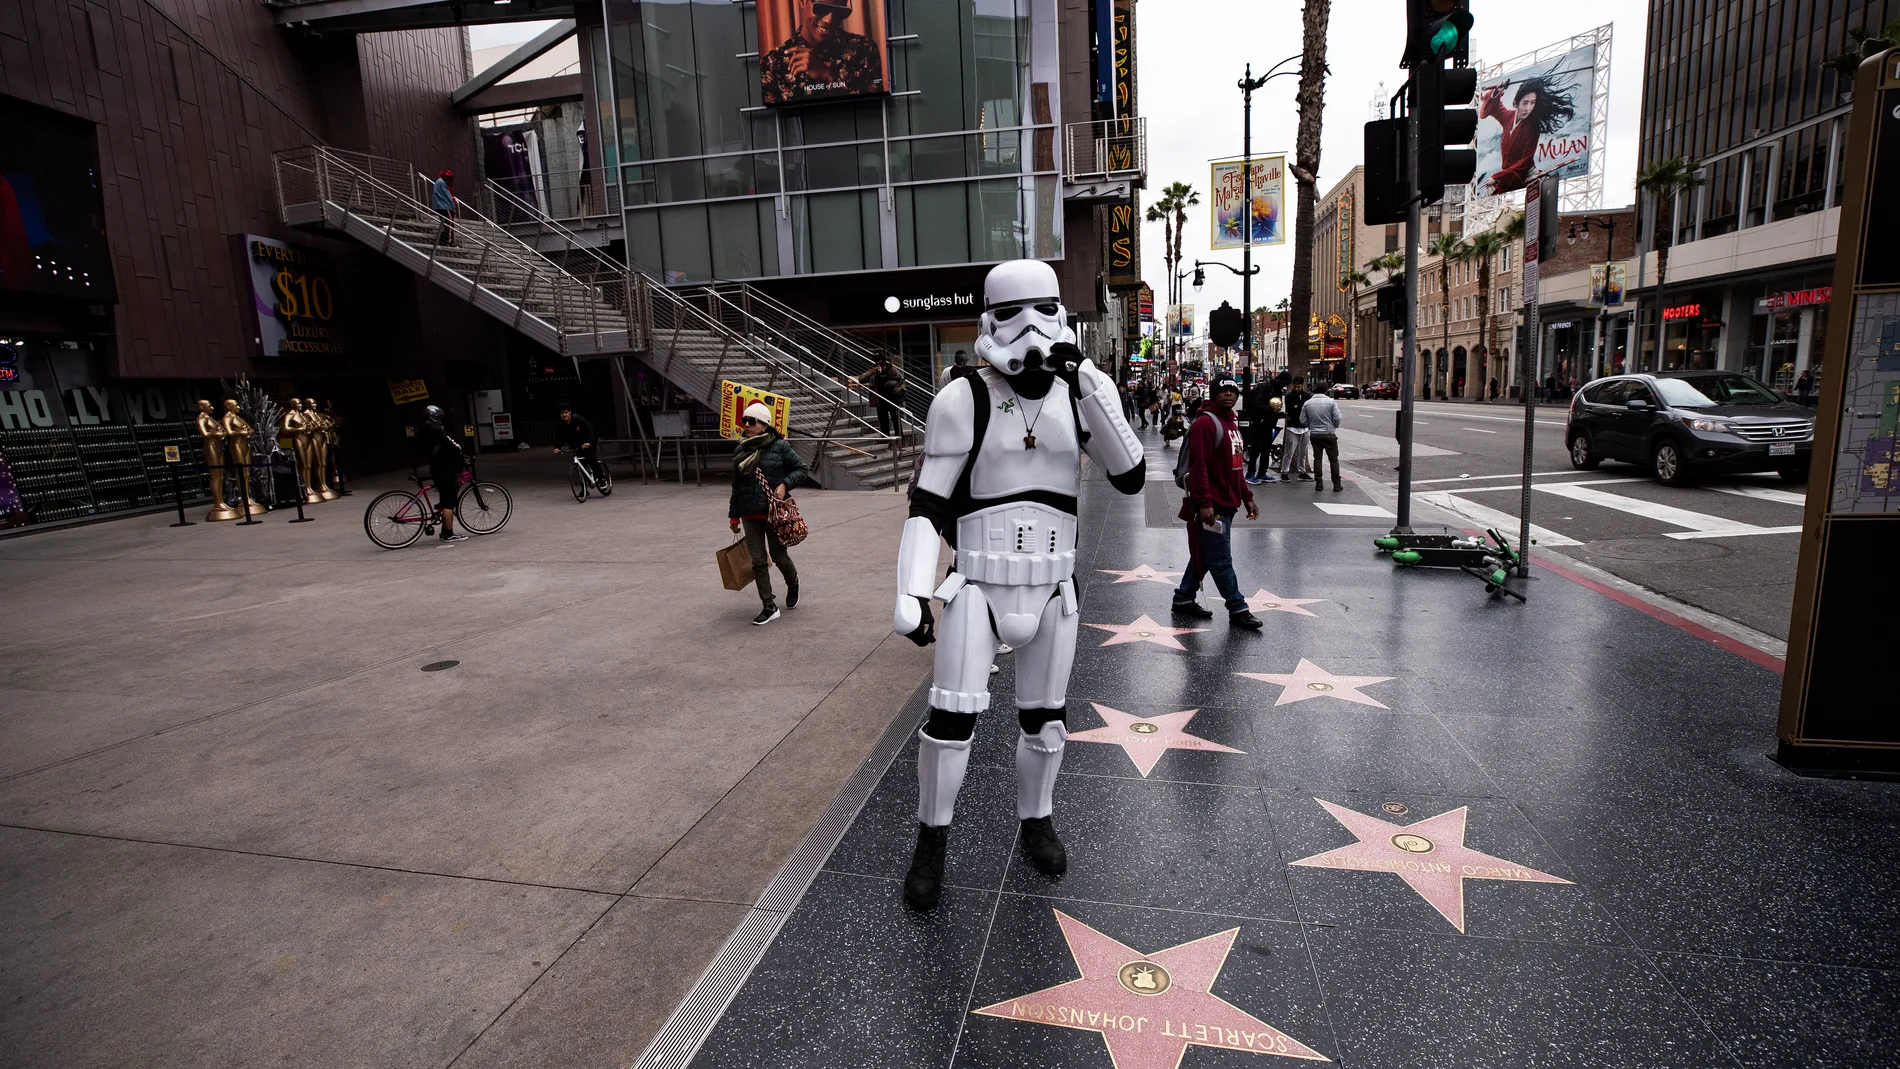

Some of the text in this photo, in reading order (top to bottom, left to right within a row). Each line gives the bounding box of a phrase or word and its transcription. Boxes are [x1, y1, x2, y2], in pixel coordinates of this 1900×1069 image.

[804, 83, 825, 91] HOUSE
[833, 81, 846, 89] SUN
[508, 143, 528, 154] TCL
[1538, 136, 1588, 162] MULAN
[1340, 212, 1349, 284] CAPITA
[276, 266, 334, 321] $10
[902, 292, 974, 310] sunglass hut
[1663, 304, 1701, 320] HOOTERS
[291, 324, 330, 339] LUXURY
[284, 339, 344, 354] ACCESSORIES
[721, 382, 734, 438] EVERYTHING'S
[775, 397, 786, 433] SALE!
[1375, 858, 1452, 874] ANTONIO
[1462, 865, 1534, 880] MARCO
[1010, 1001, 1289, 1053] SCARLETT JOHANSSON
